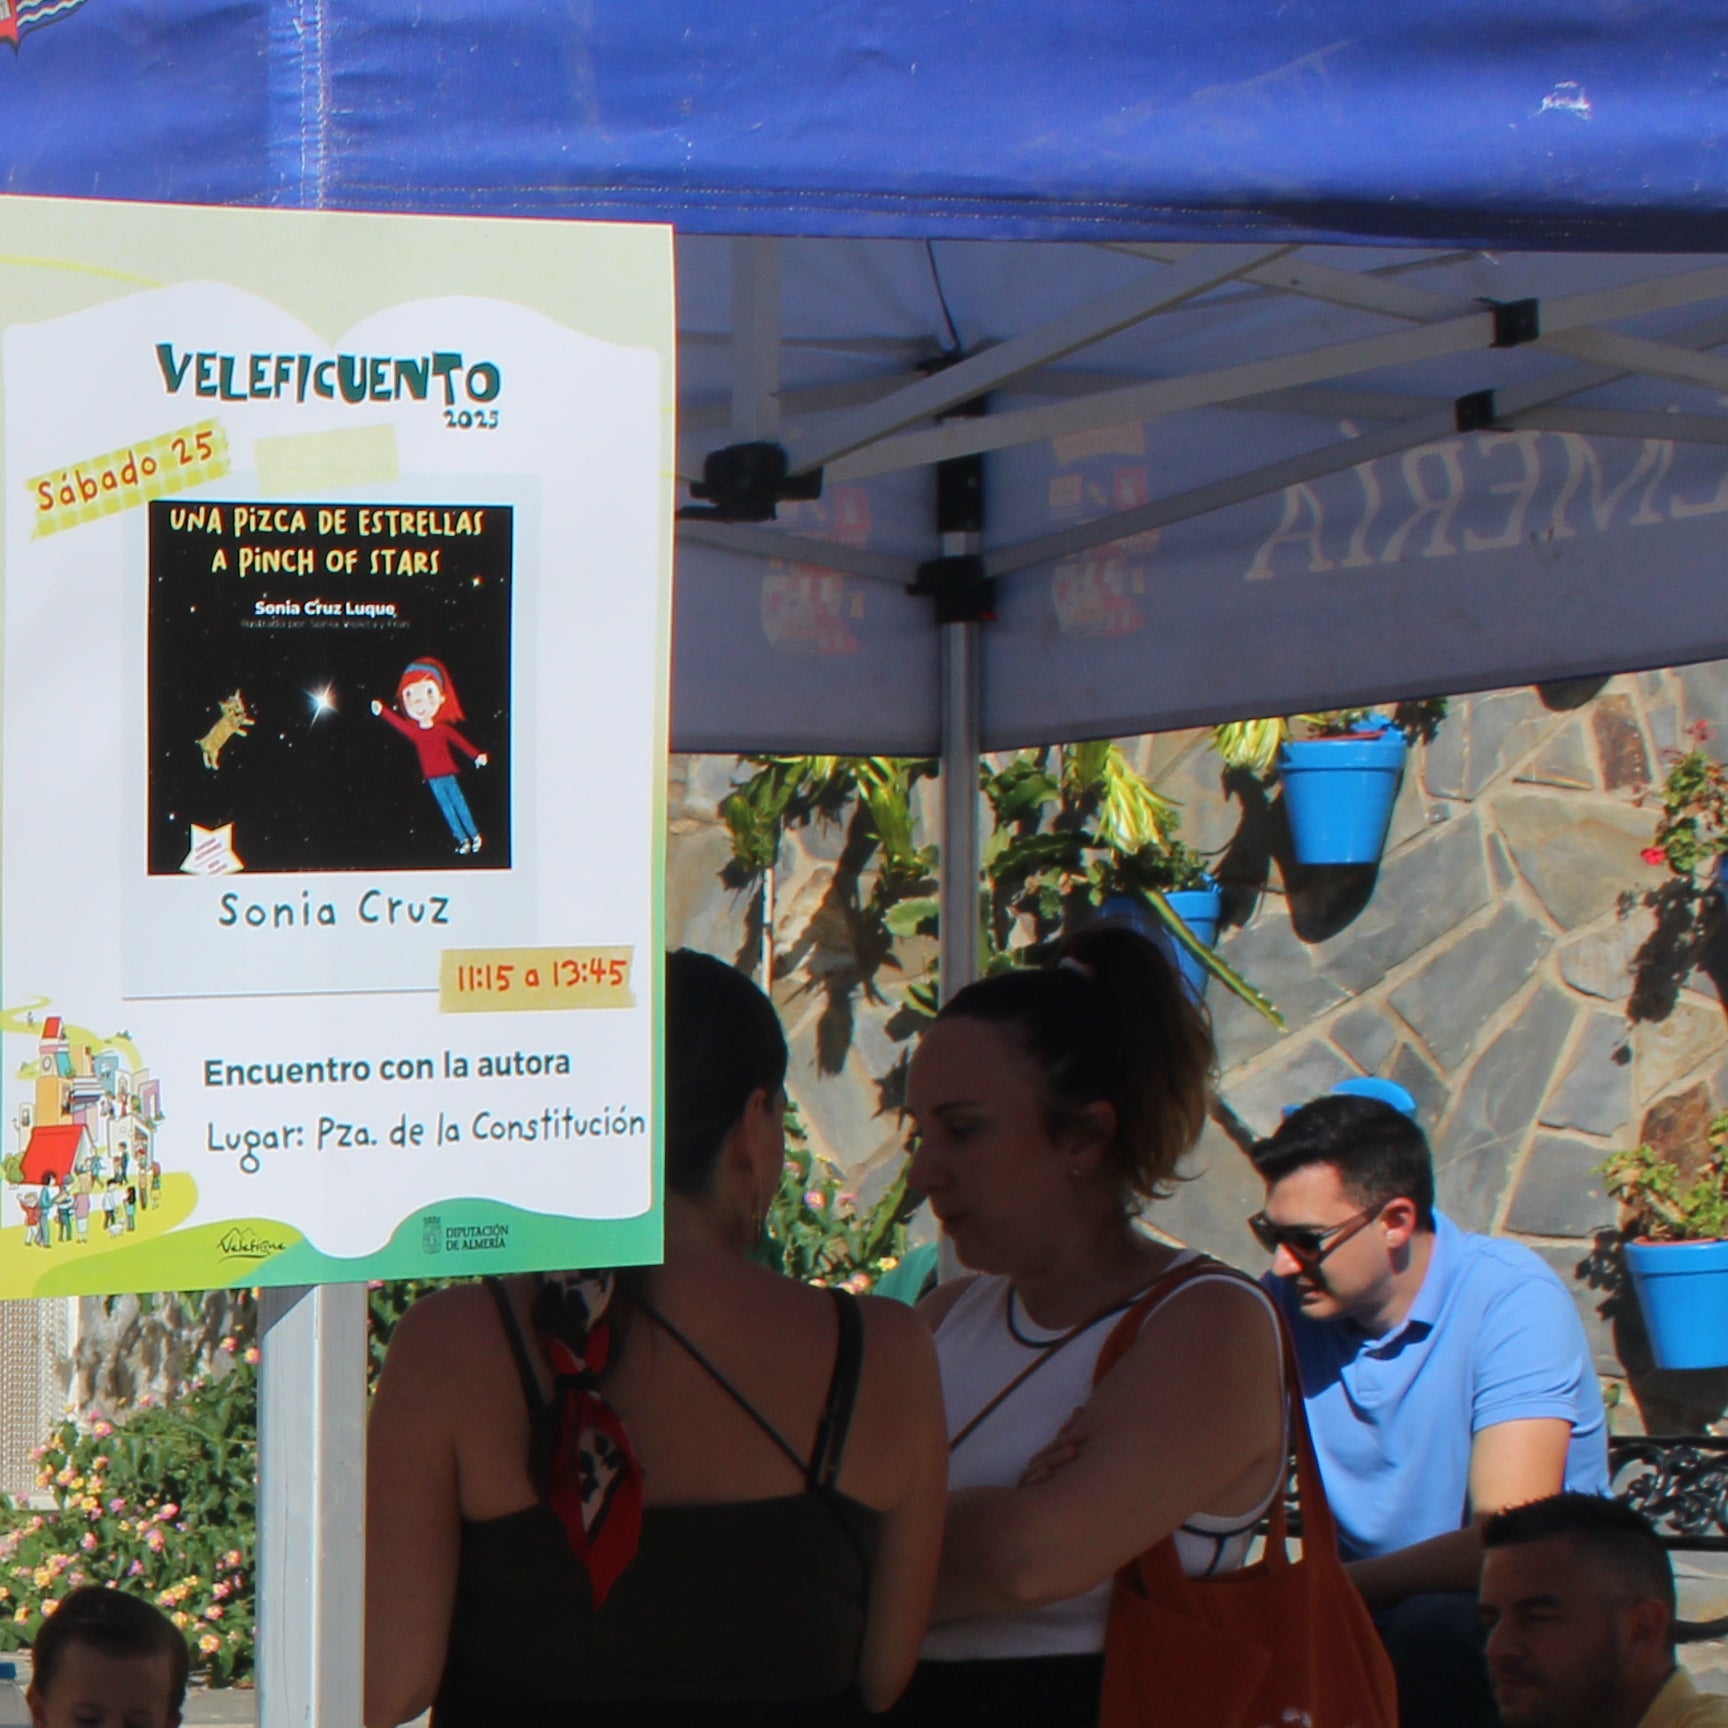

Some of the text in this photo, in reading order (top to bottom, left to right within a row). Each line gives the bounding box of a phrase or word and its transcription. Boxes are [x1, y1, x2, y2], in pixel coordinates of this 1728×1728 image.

[155, 342, 501, 405] VELEFICUENTO
[443, 409, 499, 429] 2025
[37, 429, 216, 511] Sábado 25
[169, 507, 222, 535] UNA
[318, 509, 346, 536] DE
[358, 510, 484, 537] ESTRELLAS
[211, 549, 227, 573] A
[326, 549, 358, 574] OF
[370, 549, 440, 577] STARS
[255, 601, 300, 616] Sonia
[304, 601, 342, 616] Cruz
[218, 889, 450, 928] Sonia Cruz
[457, 958, 627, 992] 11:15 a 13:45
[204, 1050, 570, 1087] Encuentro con la autora
[207, 1106, 645, 1174] Lugar: Pza. de la Constitución
[446, 1223, 509, 1239] DIPUTACIÓN
[446, 1240, 460, 1252] DE
